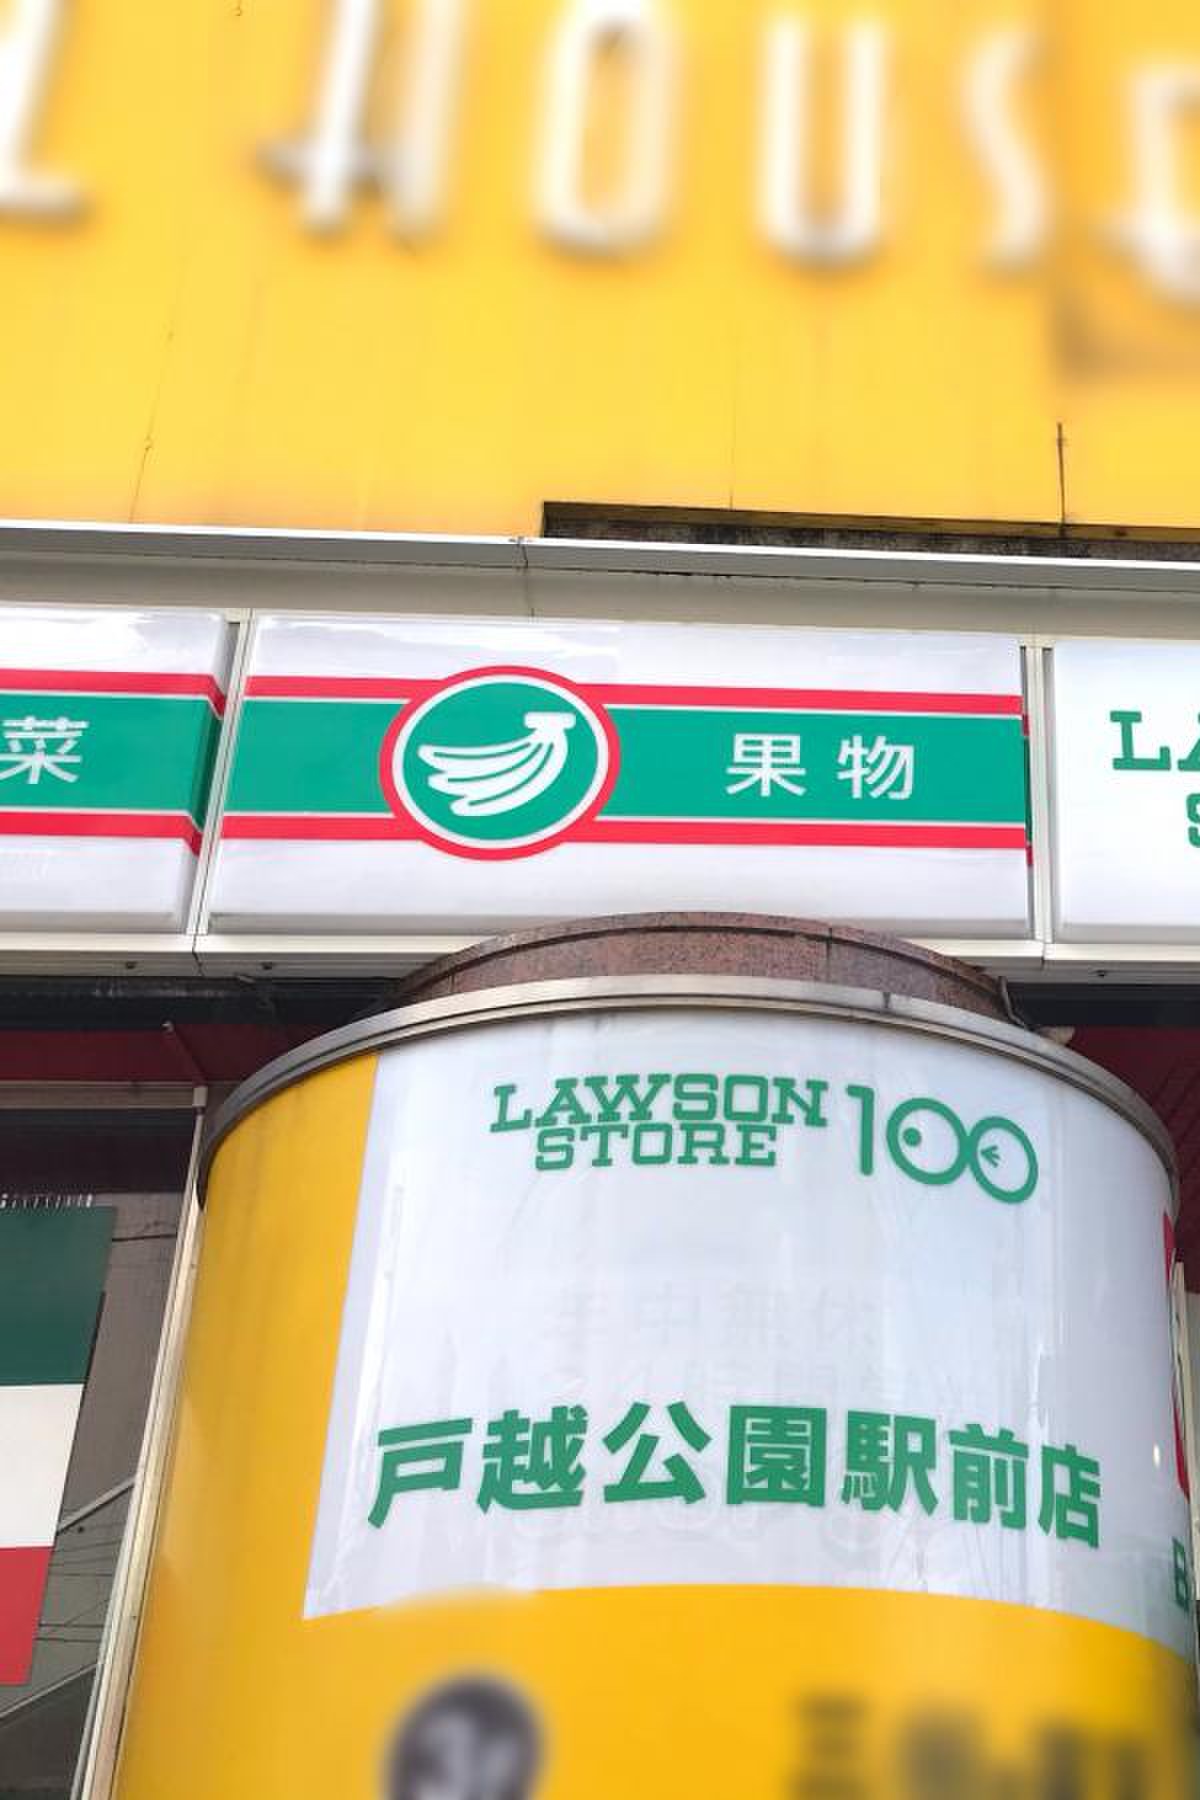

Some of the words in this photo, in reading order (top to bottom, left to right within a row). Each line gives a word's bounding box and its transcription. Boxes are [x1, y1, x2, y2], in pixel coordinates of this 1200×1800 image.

[0, 715, 89, 784] 菜
[727, 732, 915, 802] 果物
[490, 1073, 829, 1133] LAWSON
[535, 1122, 777, 1170] STORE
[847, 1084, 1039, 1204] 100
[367, 1401, 1101, 1549] 戸越公園駅前店
